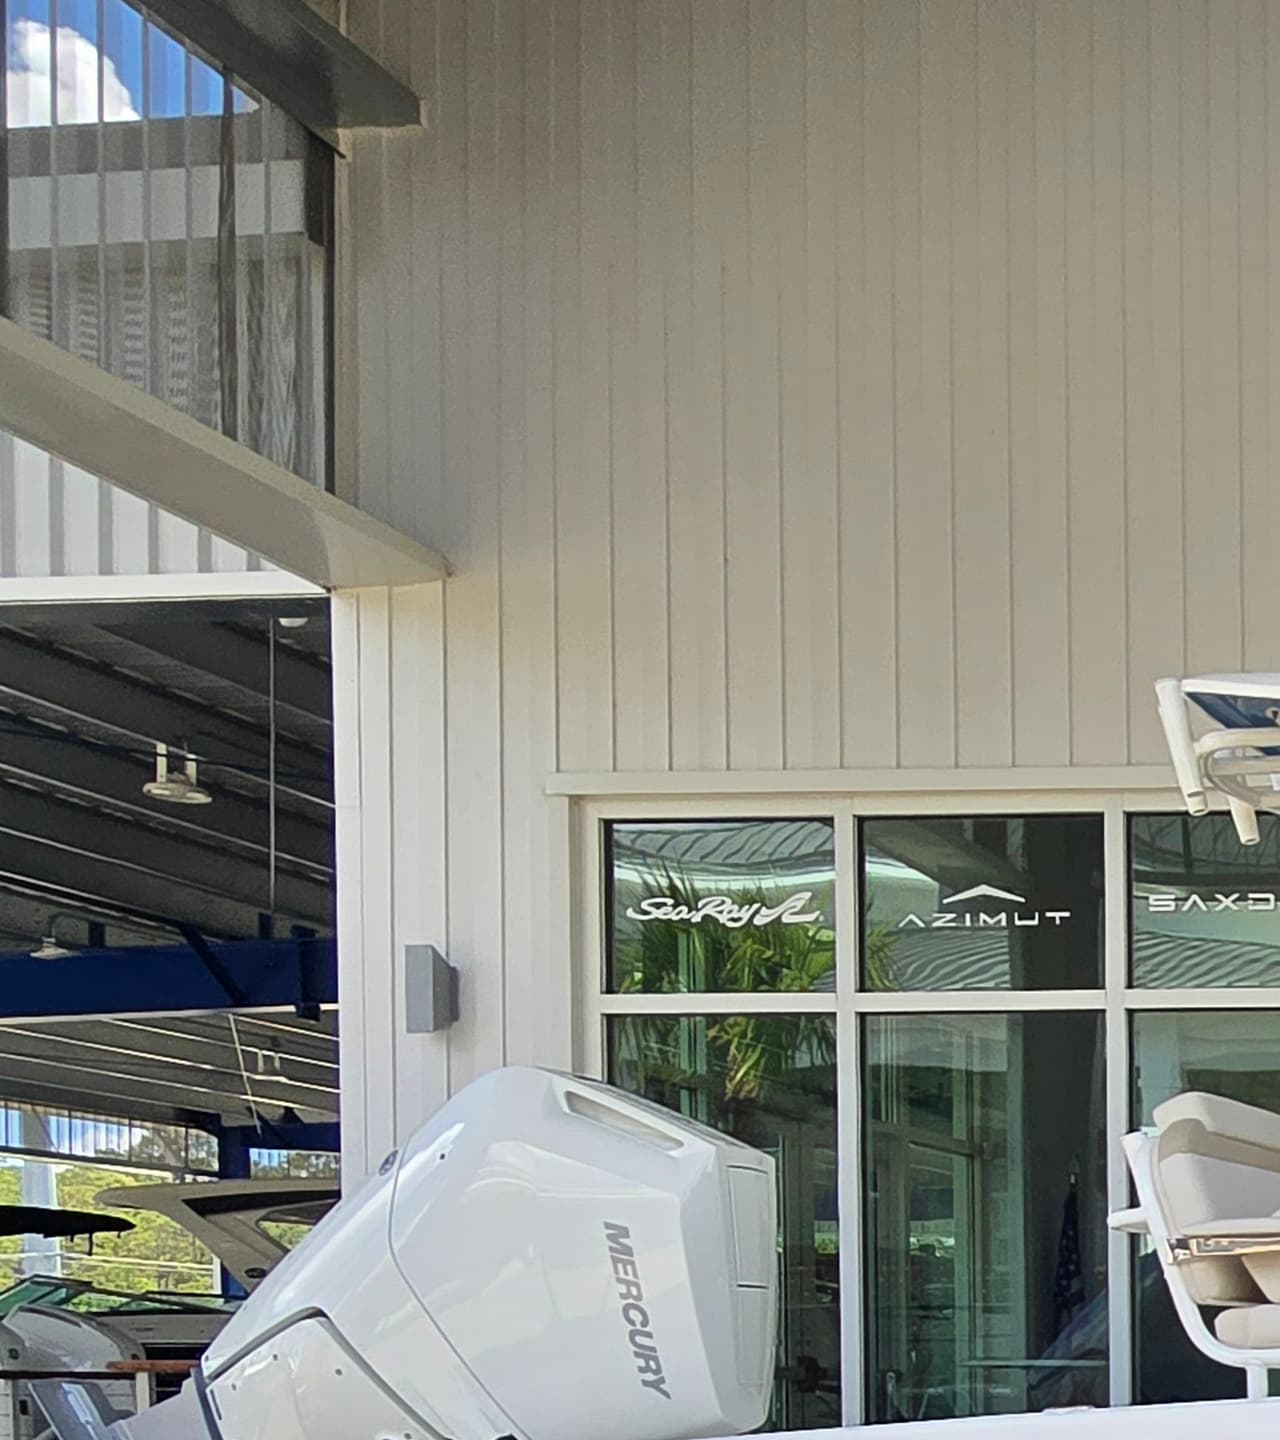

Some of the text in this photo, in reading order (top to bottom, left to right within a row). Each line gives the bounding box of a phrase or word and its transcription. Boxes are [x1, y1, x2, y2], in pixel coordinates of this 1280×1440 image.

[625, 895, 761, 928] Sea Ray
[898, 911, 1071, 928] AZIMUT
[603, 1220, 672, 1401] MERCURY
